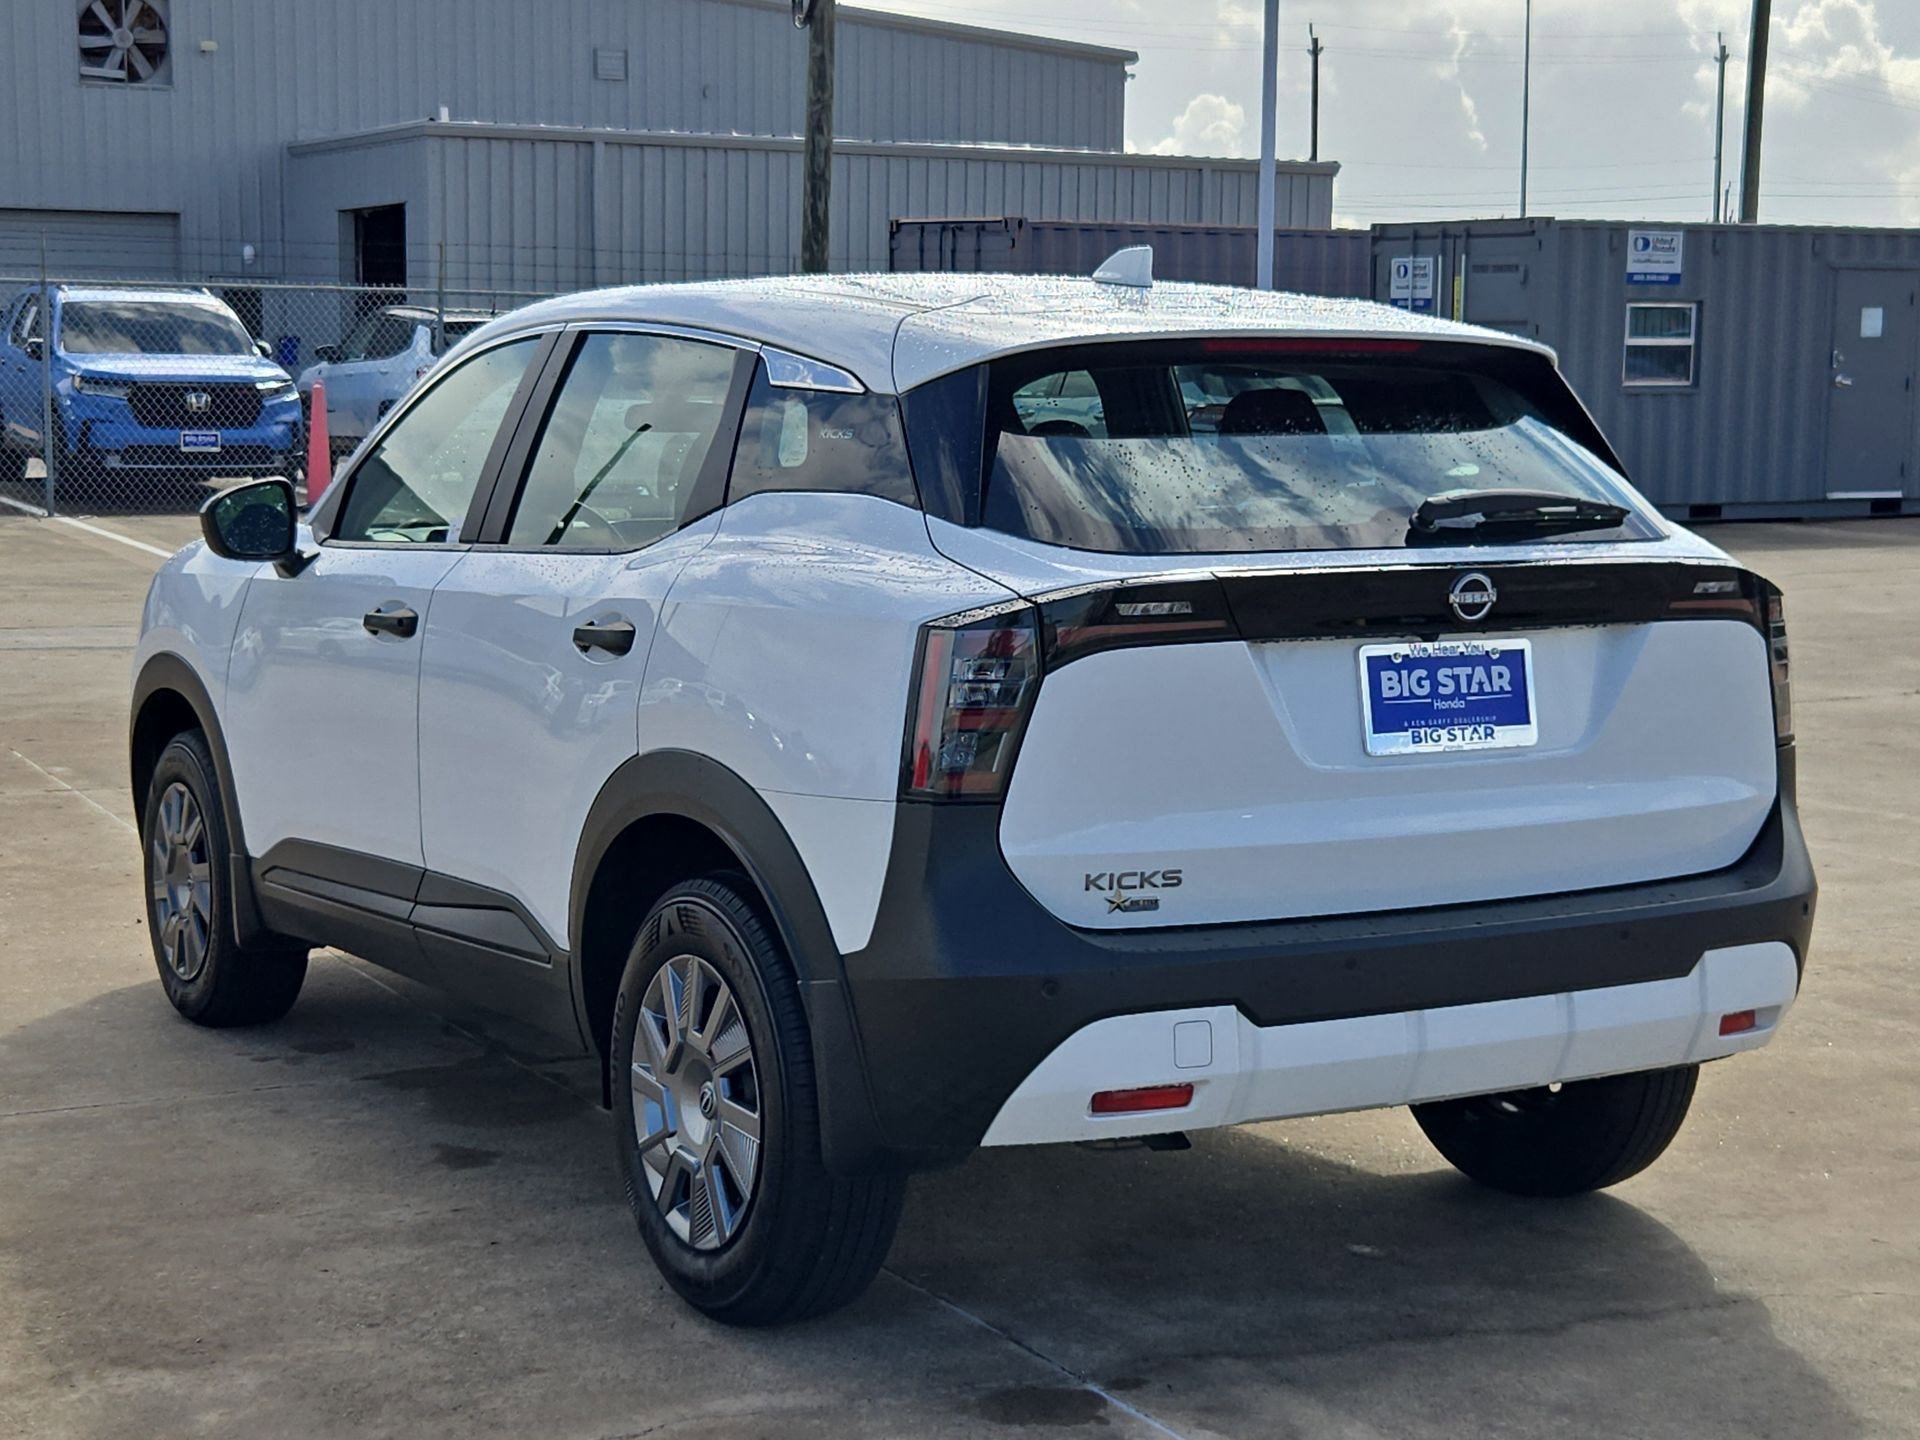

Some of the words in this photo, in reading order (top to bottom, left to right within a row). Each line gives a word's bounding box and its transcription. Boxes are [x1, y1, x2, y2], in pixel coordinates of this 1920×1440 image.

[819, 428, 854, 439] KICKS
[1409, 643, 1429, 657] We
[1433, 643, 1460, 656] Hear
[1464, 642, 1484, 655] You
[1381, 669, 1430, 698] BIG
[1437, 665, 1512, 695] STAR
[1434, 697, 1465, 710] Honda
[1411, 729, 1442, 745] BIG
[1447, 726, 1495, 743] STAR
[1084, 869, 1183, 892] KICKS
